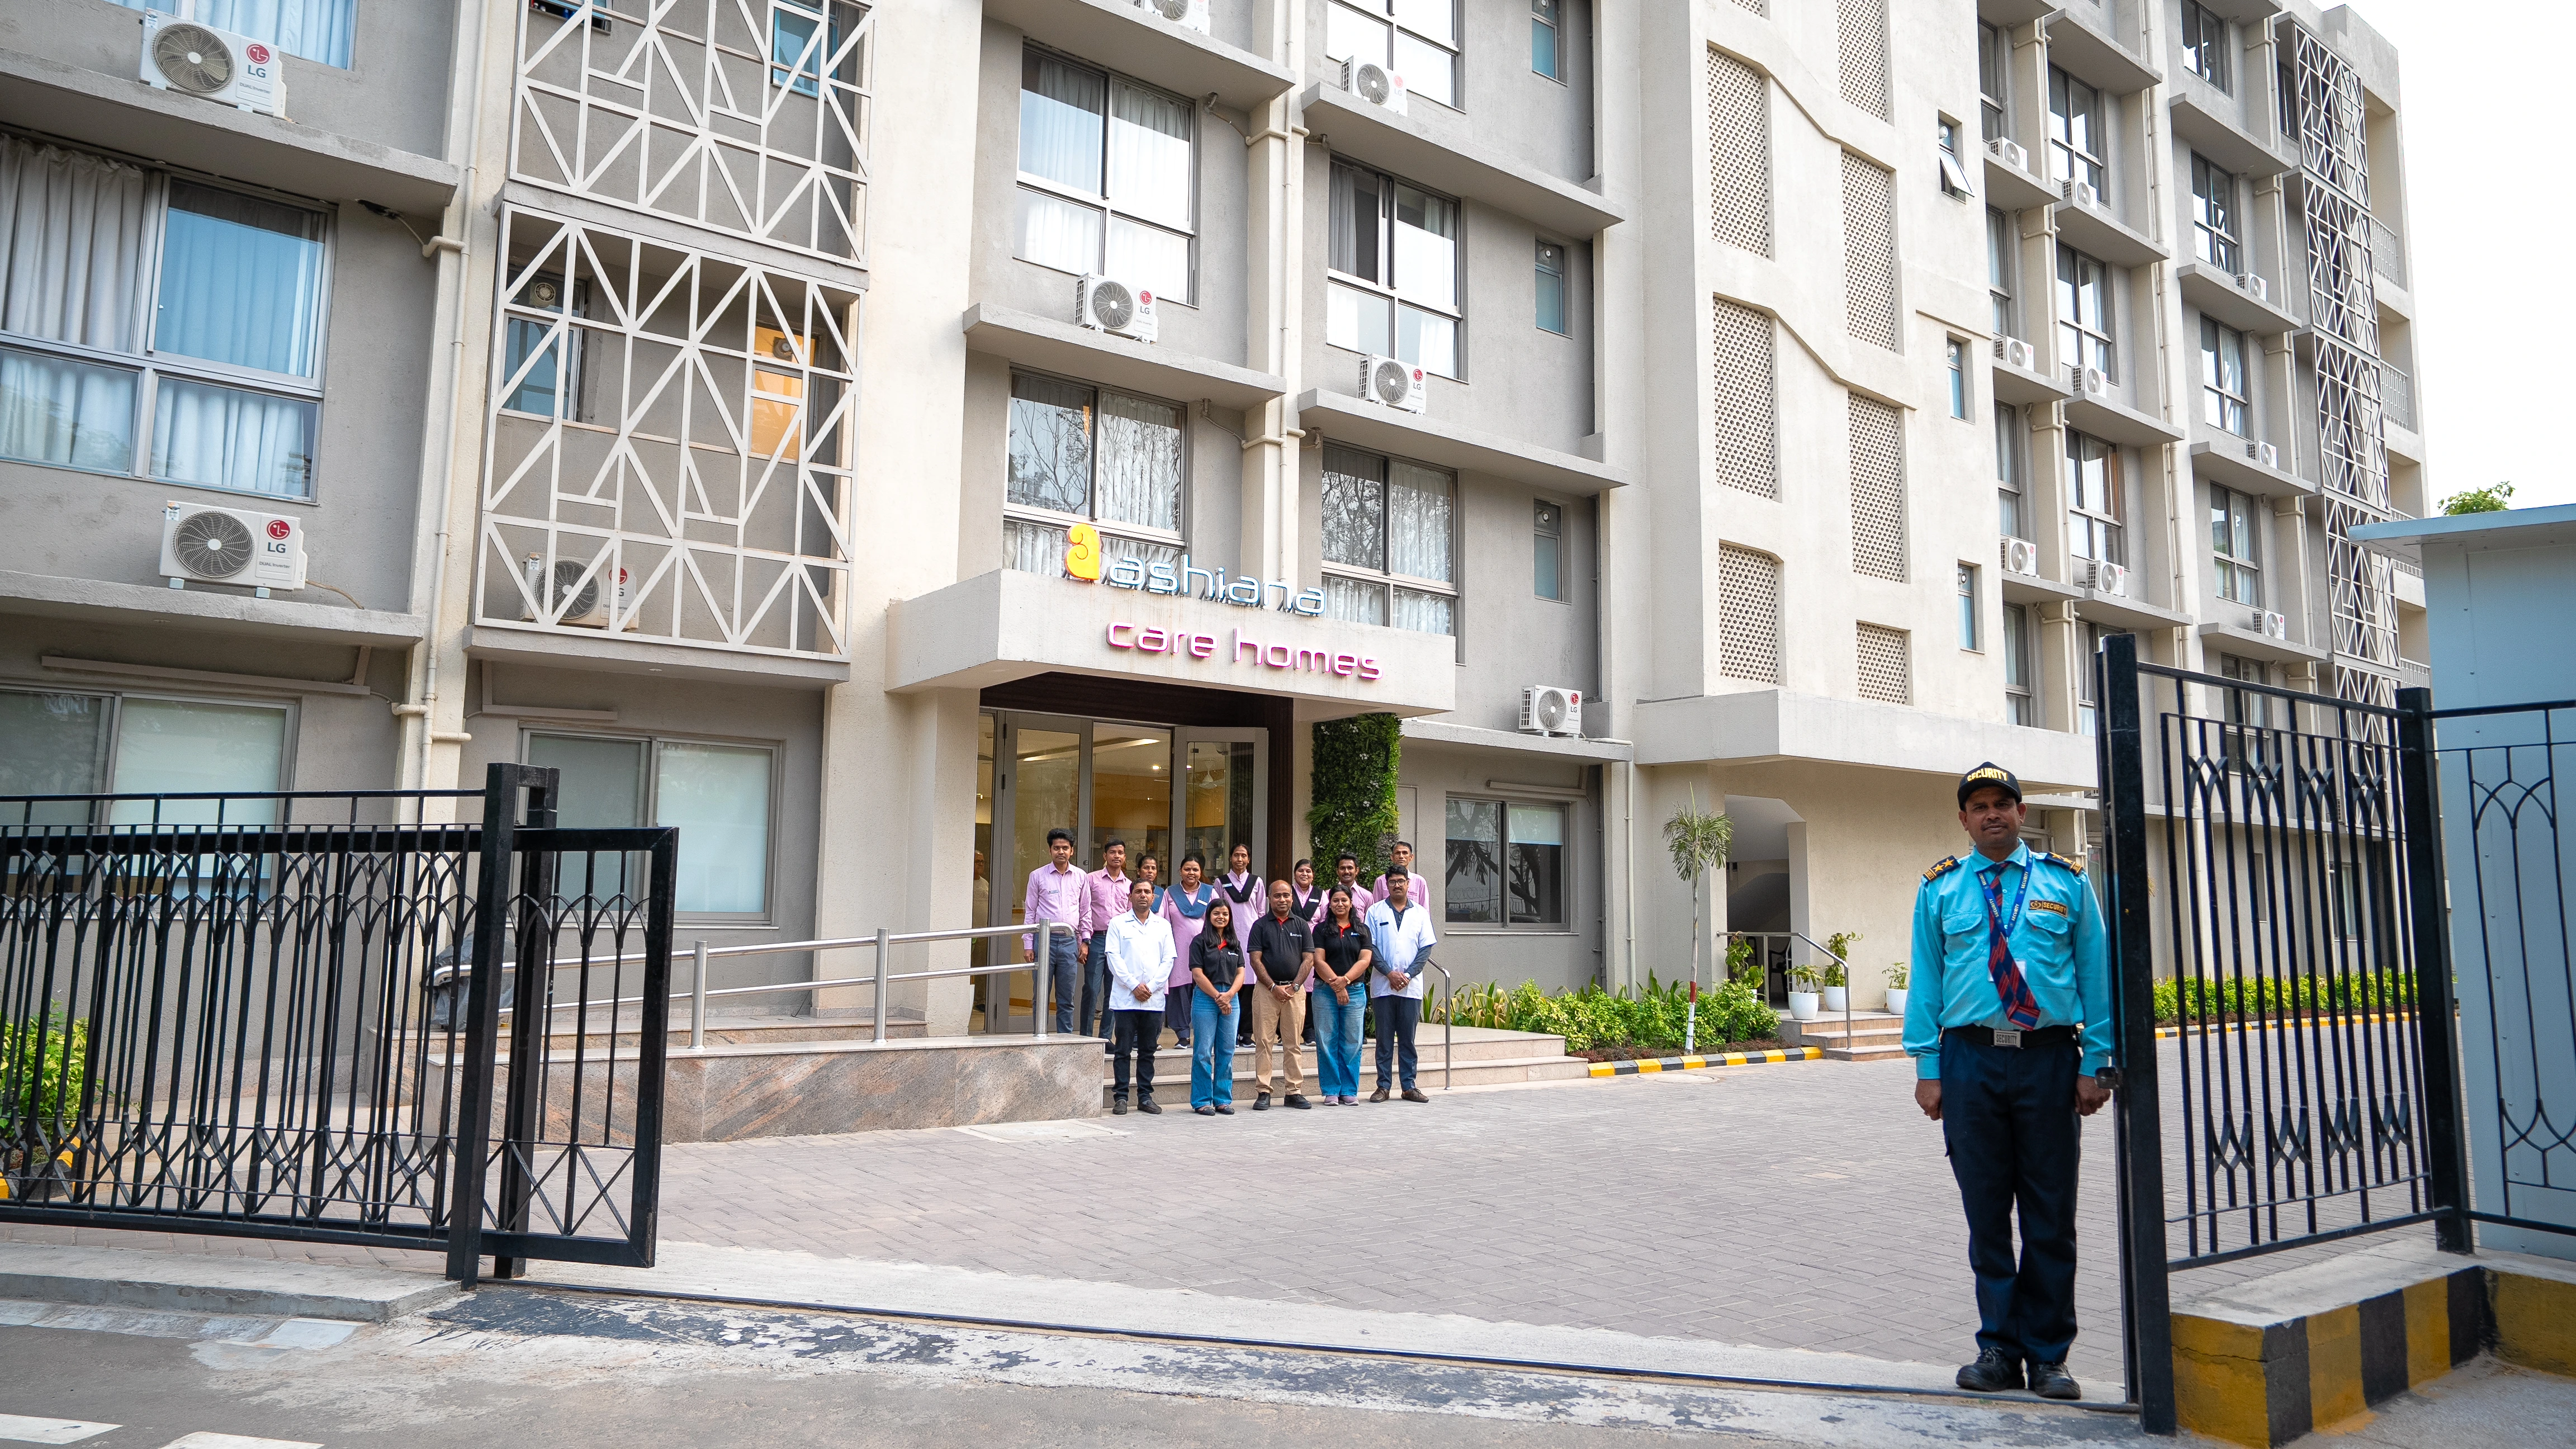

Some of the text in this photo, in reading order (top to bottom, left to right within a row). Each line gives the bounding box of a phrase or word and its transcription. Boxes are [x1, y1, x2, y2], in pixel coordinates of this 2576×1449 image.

[1194, 2, 1204, 12] LG
[248, 64, 266, 78] LG
[1394, 88, 1402, 96] LG
[1140, 306, 1150, 315] LG
[267, 542, 286, 553] LG
[1106, 554, 1327, 615] ashiana
[1106, 621, 1384, 680] care homes
[1967, 768, 2007, 782] SECURITY
[2020, 871, 2029, 889] SECURITY
[1989, 898, 2000, 918] SECURITY
[2011, 903, 2020, 921] SECURITY
[2043, 902, 2067, 913] SECURITY
[1996, 1034, 2017, 1044] SECURITY
